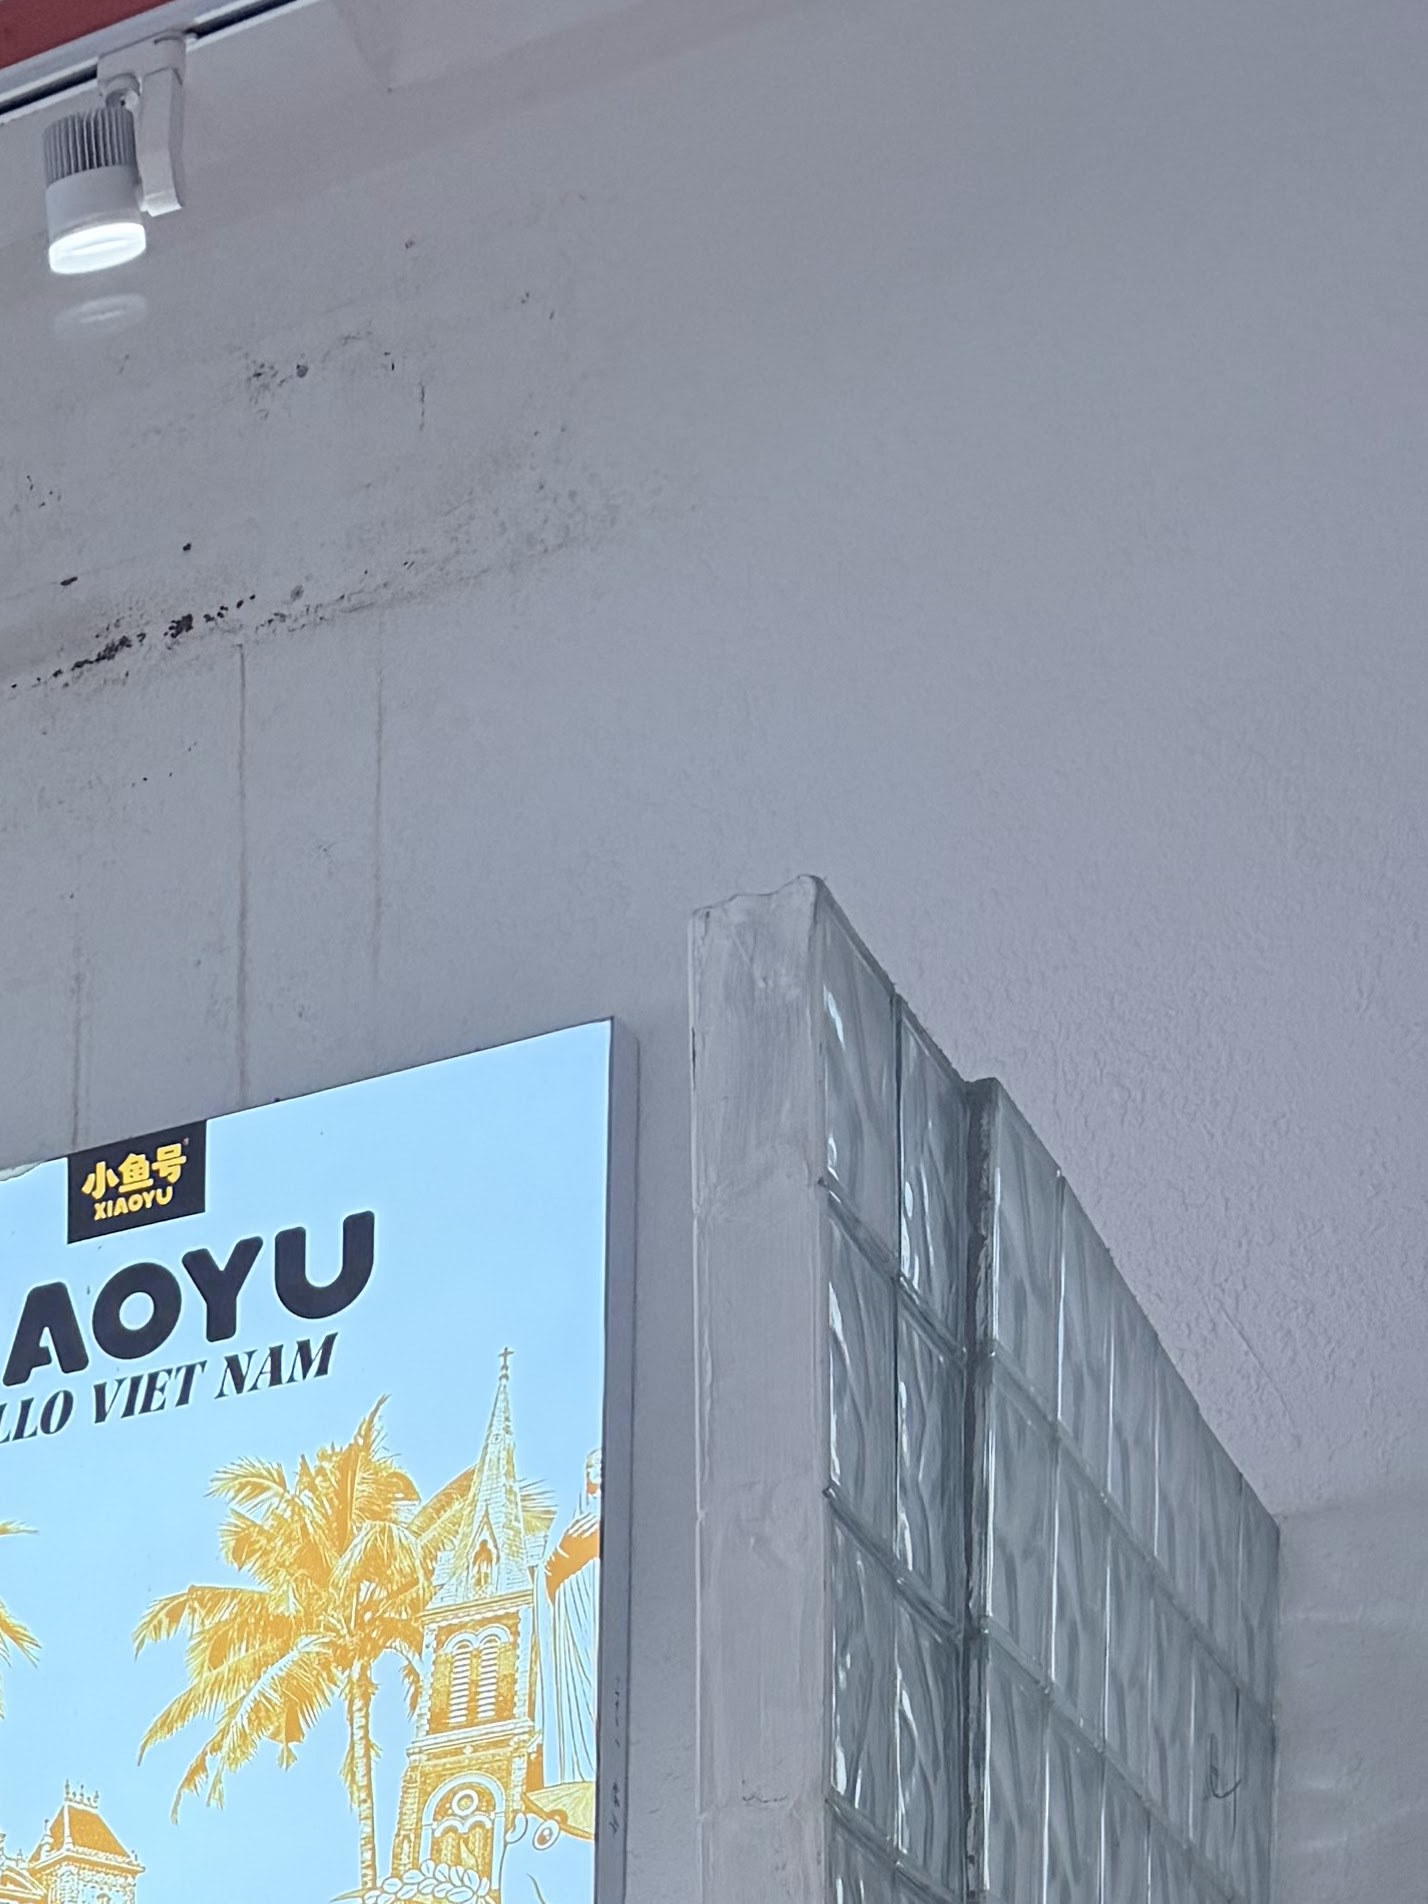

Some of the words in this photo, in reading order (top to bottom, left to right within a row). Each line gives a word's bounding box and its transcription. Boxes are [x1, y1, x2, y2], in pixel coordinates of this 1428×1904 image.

[80, 1143, 187, 1200] 小鱼号
[93, 1186, 174, 1221] XIAOYU
[94, 1360, 207, 1427] VIET
[215, 1332, 339, 1400] NAM
